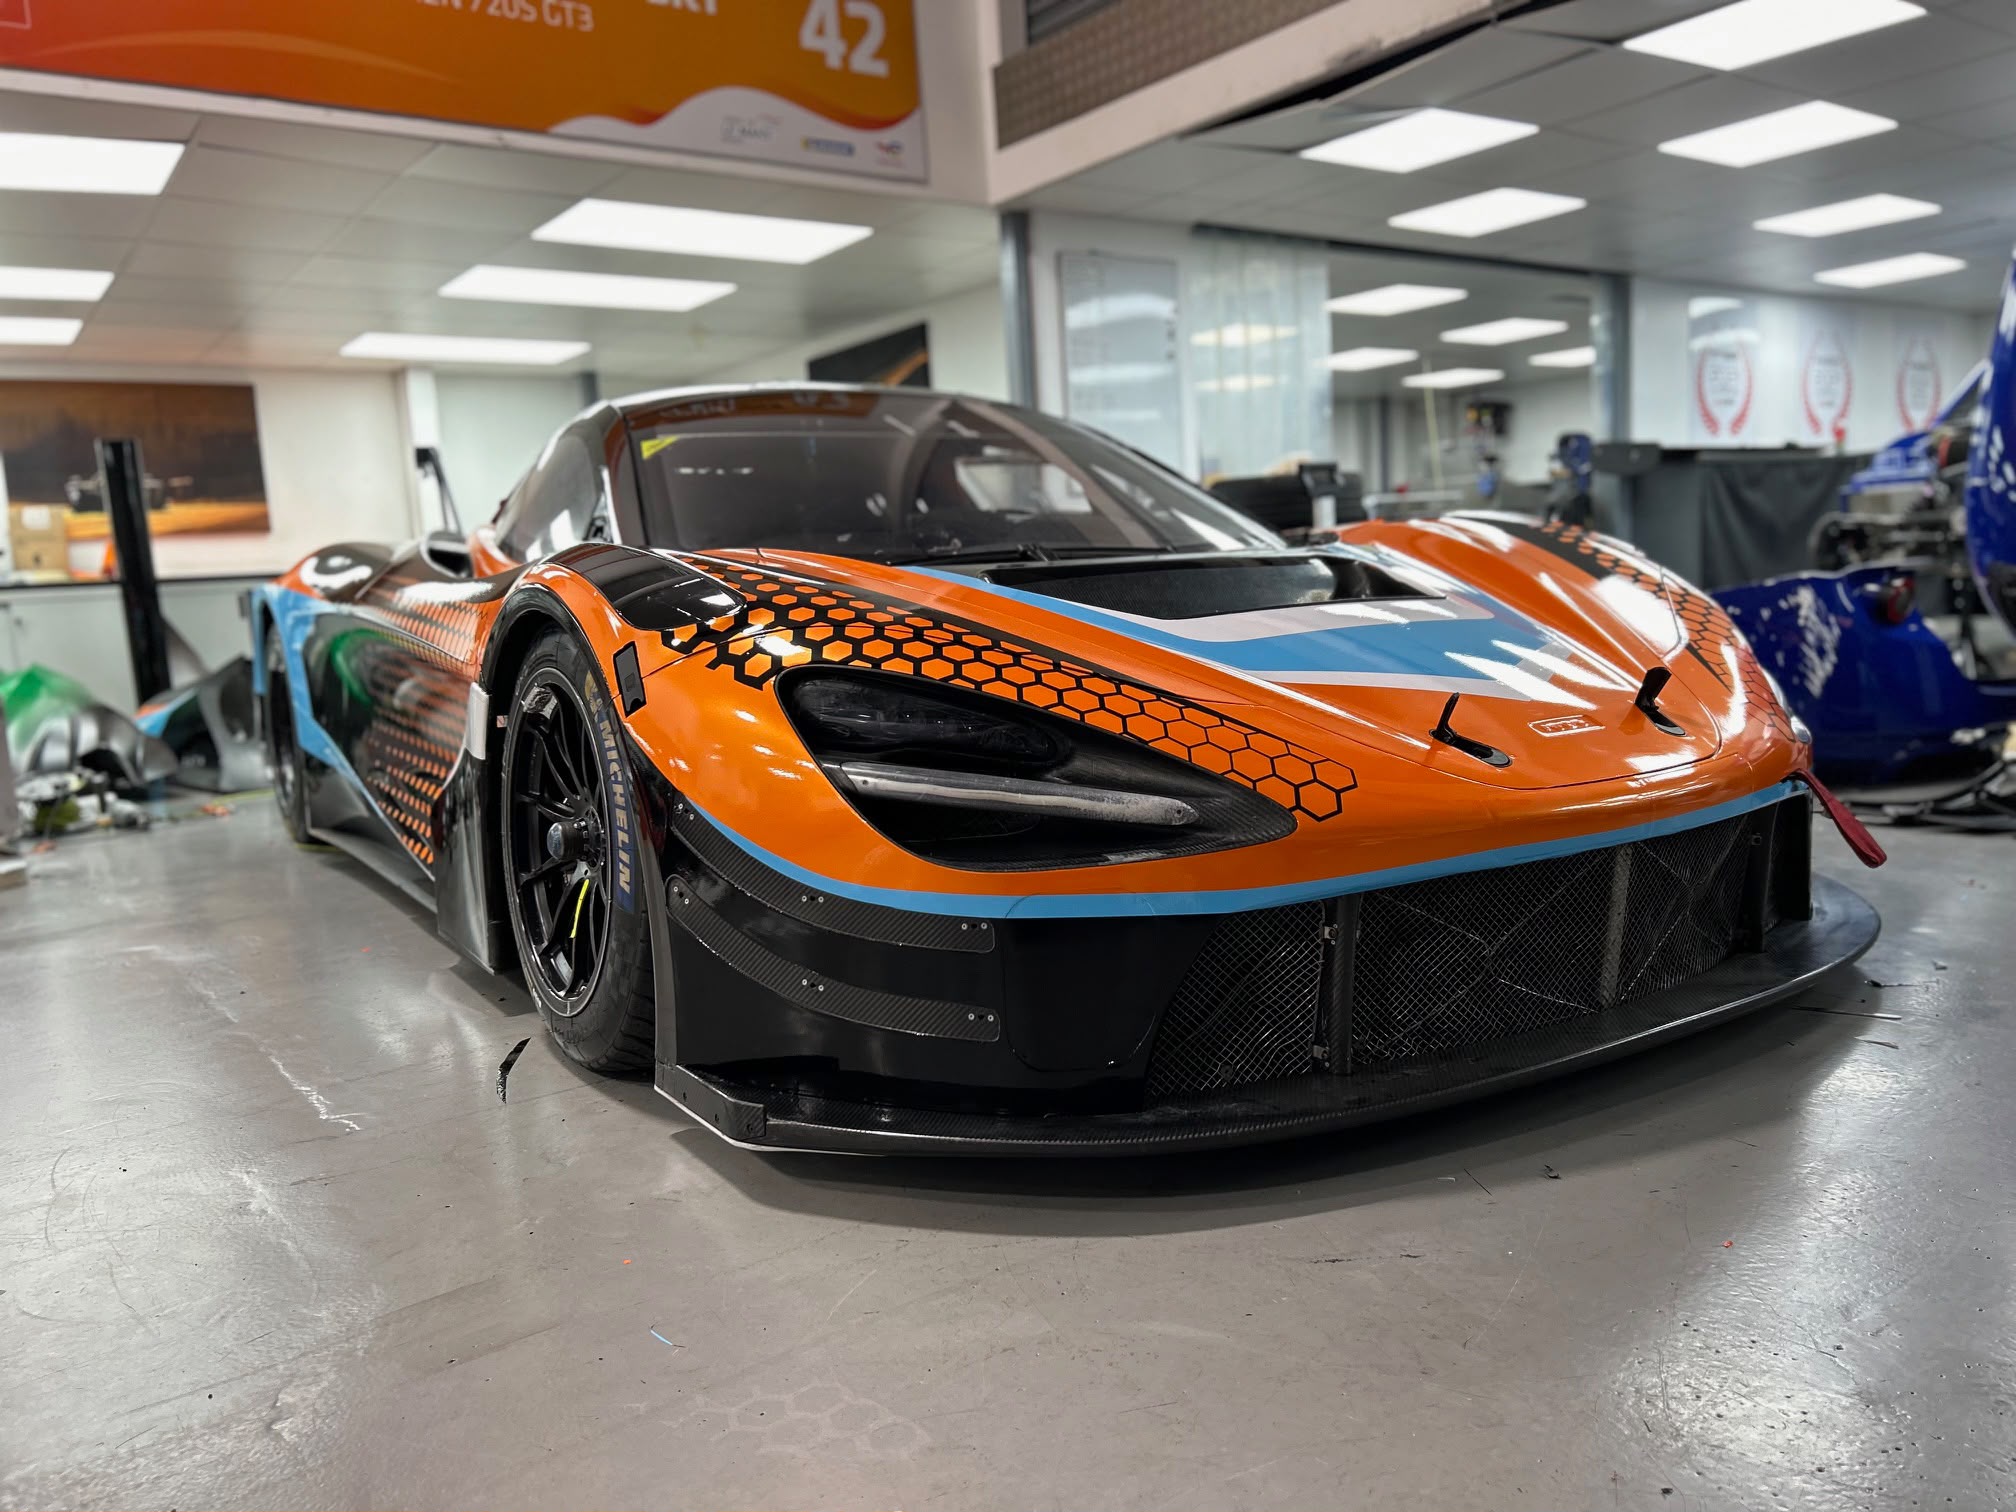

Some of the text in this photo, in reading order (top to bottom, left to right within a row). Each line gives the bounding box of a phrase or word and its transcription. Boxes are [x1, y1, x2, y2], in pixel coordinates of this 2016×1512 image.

[541, 0, 595, 32] GT3
[798, 0, 889, 77] 42
[600, 720, 632, 895] MICHELIN
